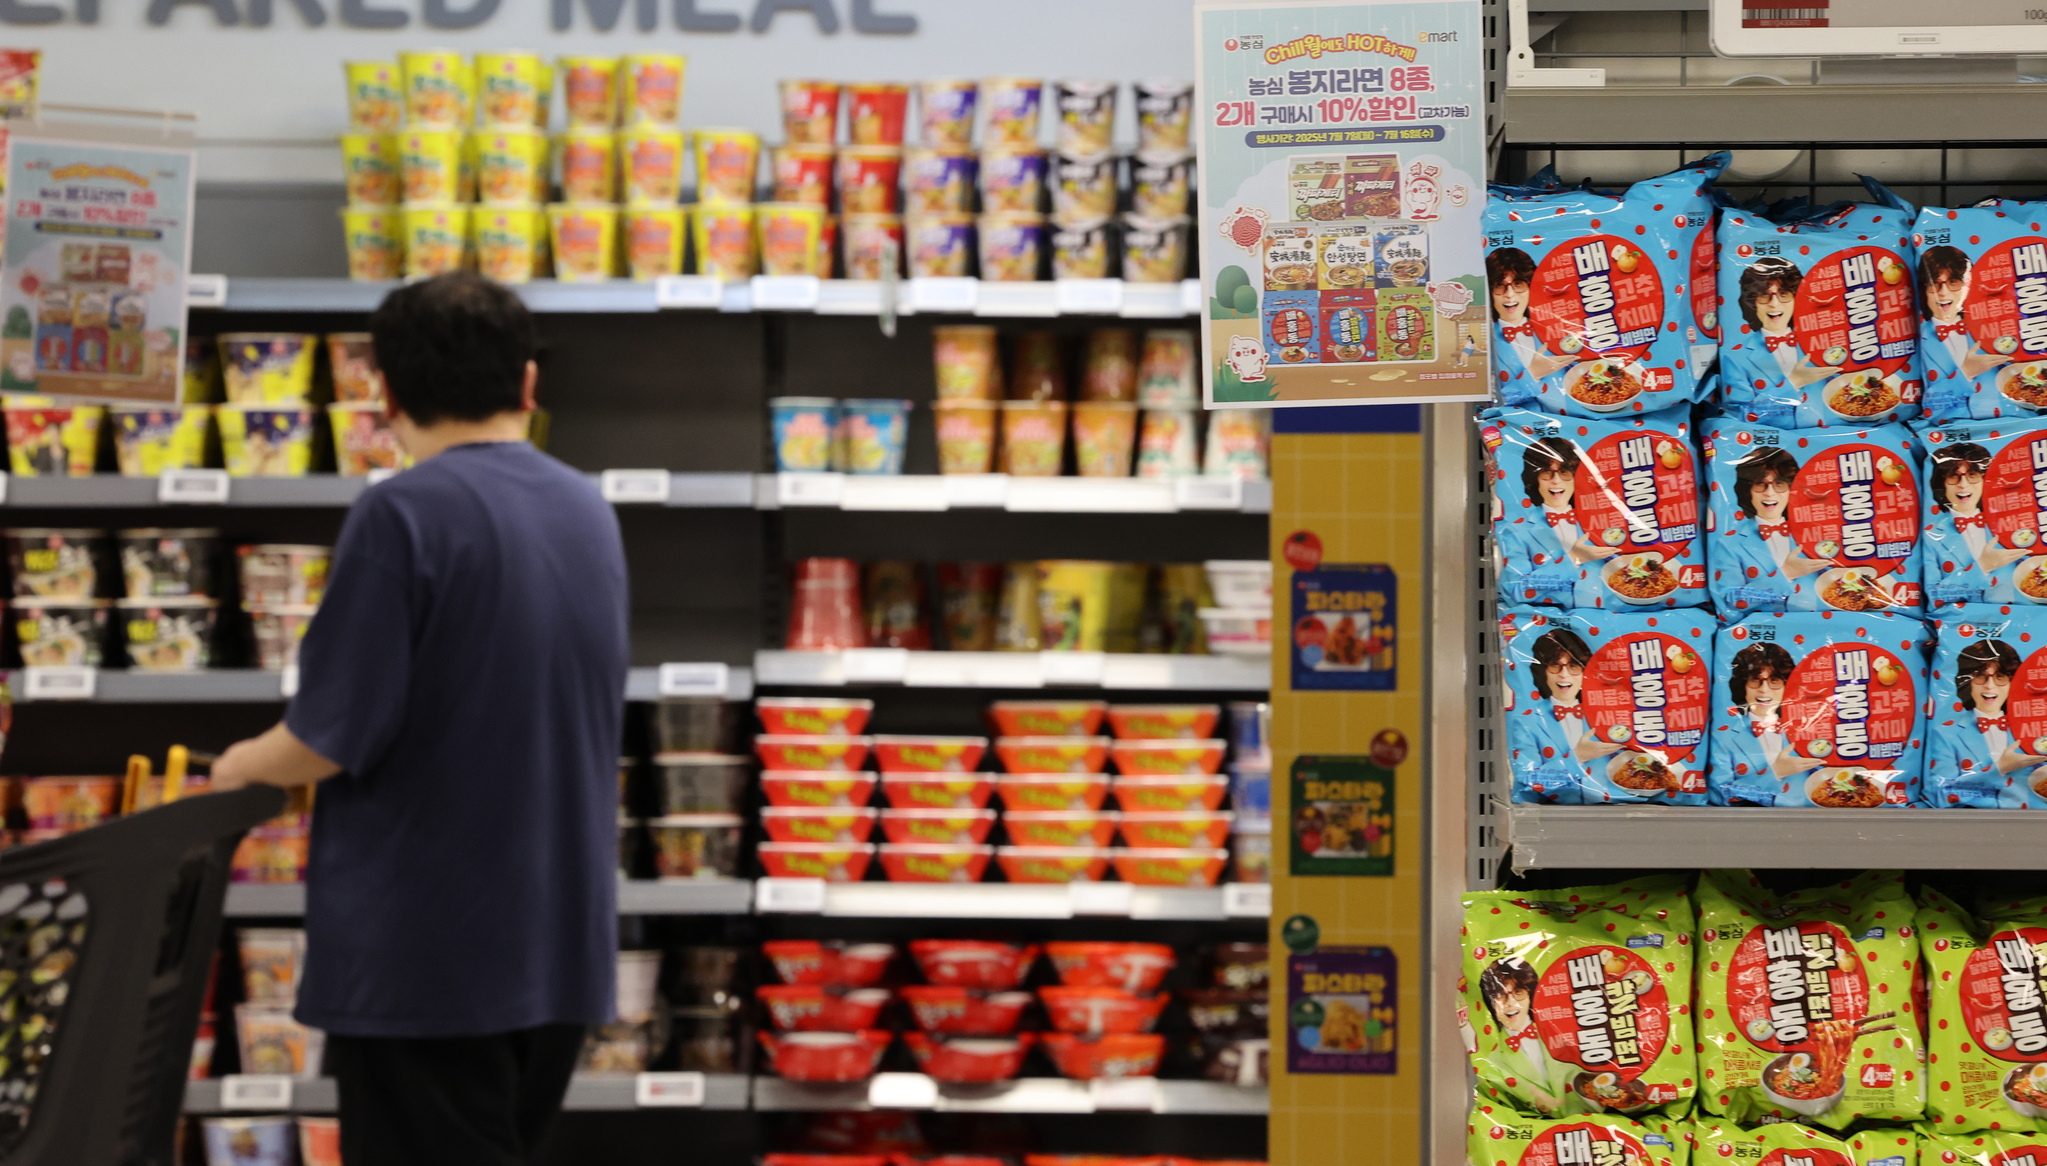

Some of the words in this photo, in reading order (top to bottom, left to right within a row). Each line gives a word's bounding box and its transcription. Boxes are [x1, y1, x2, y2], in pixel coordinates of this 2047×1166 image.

[1240, 39, 1263, 50] 농심
[1418, 31, 1458, 43] emart
[1265, 35, 1345, 64] Chill월에도
[1347, 33, 1417, 62] HOT하게!
[1249, 77, 1283, 95] 농심
[1288, 68, 1384, 95] 봉지라면
[1390, 66, 1435, 92] 8종,
[1216, 101, 1255, 126] 2개
[1261, 105, 1313, 125] 구매시
[1317, 96, 1416, 122] 10%할인
[1295, 132, 1327, 142] 2025년
[1328, 132, 1343, 141] 7월
[1383, 130, 1398, 140] 7월
[1489, 234, 1514, 247] 농심
[1924, 233, 1950, 245] 농심
[1327, 251, 1367, 263] 안성탕면
[1551, 253, 1573, 267] 시원
[1753, 245, 1781, 257] 농심
[1988, 253, 2010, 267] 시원
[1818, 265, 1840, 279] 시원
[1613, 274, 1655, 303] 고추
[1809, 277, 1843, 293] 달달한
[1573, 240, 1620, 352] 배홍동
[2011, 243, 2047, 354] 배홍동
[1535, 298, 1580, 322] 매콤한
[1617, 303, 1658, 329] 치미
[1841, 252, 1879, 364] 배홍동
[1969, 298, 2015, 321] 매콤한
[1799, 310, 1846, 333] 매콤한
[1879, 315, 1916, 341] 치미
[1619, 327, 1658, 348] 비빔면
[1880, 342, 1916, 359] 비빔면
[1643, 370, 1673, 390] 4개입
[1752, 434, 1780, 445] 농심
[1944, 432, 1971, 443] 농심
[1595, 446, 1617, 460] 시원
[2008, 446, 2029, 460] 시원
[1814, 459, 1836, 472] 시원
[1999, 459, 2031, 474] 달달한
[1658, 470, 1695, 500] 고추
[1805, 472, 1839, 486] 달달한
[1619, 435, 1661, 546] 배홍동
[1838, 450, 1876, 561] 배홍동
[1875, 489, 1914, 514] 고추
[1987, 492, 2033, 514] 매콤한
[1659, 500, 1697, 523] 치미
[1793, 503, 1840, 523] 매콤한
[1589, 511, 1625, 531] 새콤
[1876, 517, 1914, 540] 치미
[1801, 523, 1839, 543] 새콤
[1876, 541, 1912, 558] 비빔면
[1749, 629, 1776, 641] 농심
[1810, 655, 1833, 669] 시원
[1801, 670, 1834, 684] 달달한
[1587, 689, 1631, 706] 매콤한
[1628, 638, 1666, 746] 배홍동
[1666, 676, 1705, 703] 고추
[1834, 649, 1870, 760] 배홍동
[1871, 689, 1910, 714] 고추
[1667, 706, 1704, 728] 치미
[1667, 729, 1702, 746] 비빔면
[1870, 718, 1907, 739] 치미
[1869, 742, 1903, 759] 비빔면
[1718, 927, 1743, 940] 농심
[1975, 948, 1997, 962] 시원
[1969, 959, 1999, 975] 달달한
[1548, 973, 1568, 985] 시원
[1763, 926, 1809, 1045] 배홍동
[1994, 937, 2047, 1056] 배홍동
[1567, 953, 1614, 1066] 배홍동
[1549, 1032, 1576, 1050] 새콤
[1506, 1128, 1533, 1140] 농심
[1531, 1142, 1553, 1154] 시원
[1735, 1147, 1762, 1158] 농심
